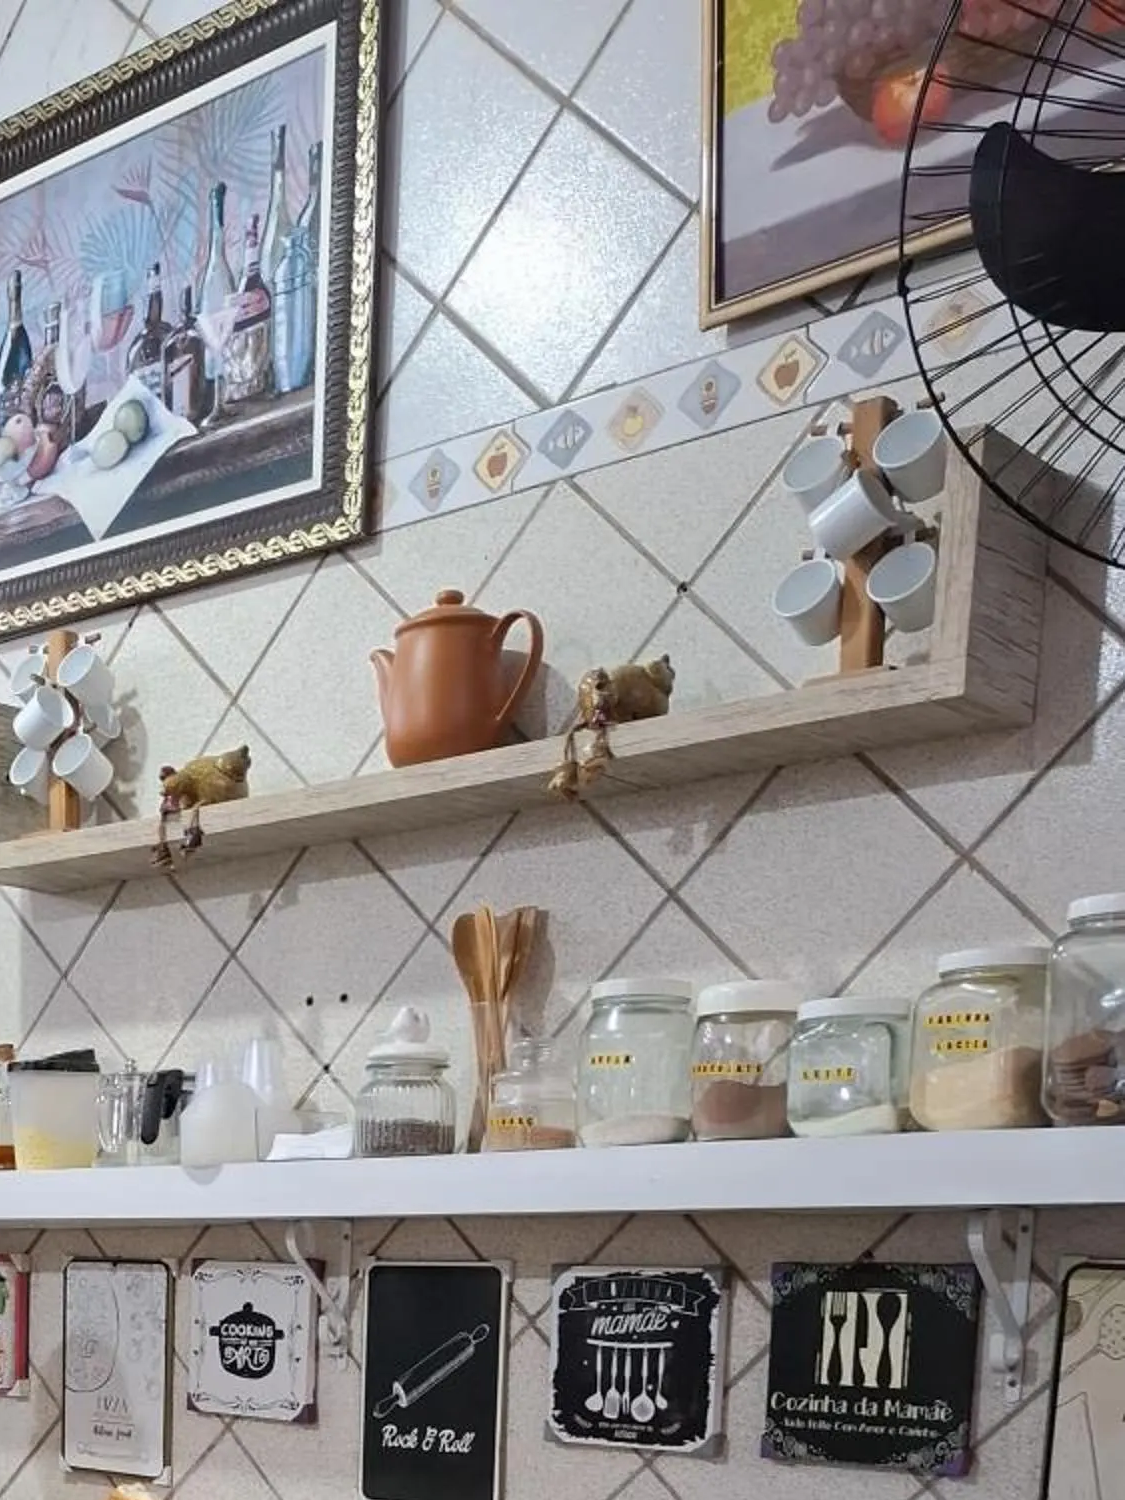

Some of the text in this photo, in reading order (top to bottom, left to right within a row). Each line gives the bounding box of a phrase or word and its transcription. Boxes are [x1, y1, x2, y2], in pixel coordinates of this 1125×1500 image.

[220, 1323, 274, 1338] COOKING
[771, 1391, 953, 1422] Cozinha da Mamãe
[382, 1423, 419, 1449] Rock
[438, 1429, 475, 1453] Roll
